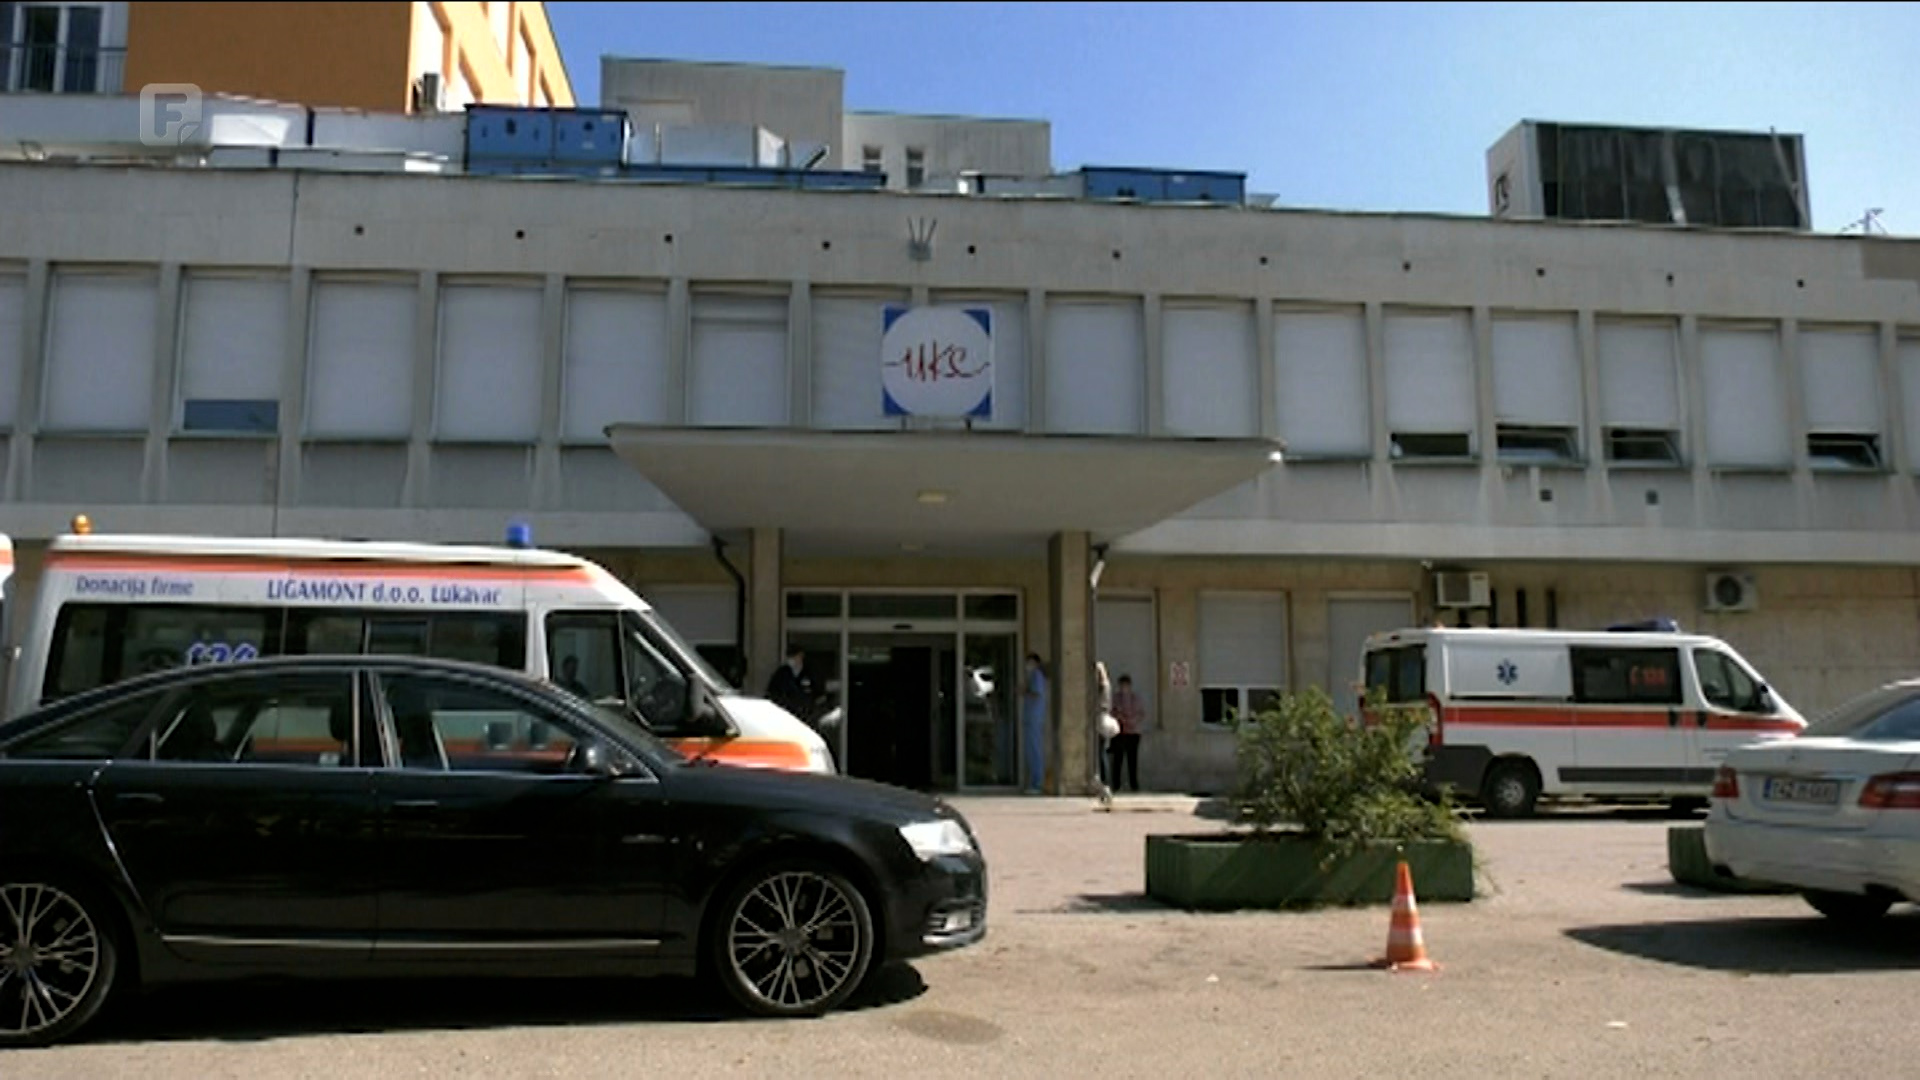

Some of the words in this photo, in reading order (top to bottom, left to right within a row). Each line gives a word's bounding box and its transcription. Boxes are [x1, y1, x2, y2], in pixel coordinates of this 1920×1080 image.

[76, 575, 146, 597] Donacija
[151, 576, 195, 596] firme
[267, 579, 367, 601] LIGAMONT
[372, 582, 425, 603] d.o.o.
[431, 583, 502, 605] Lukavac
